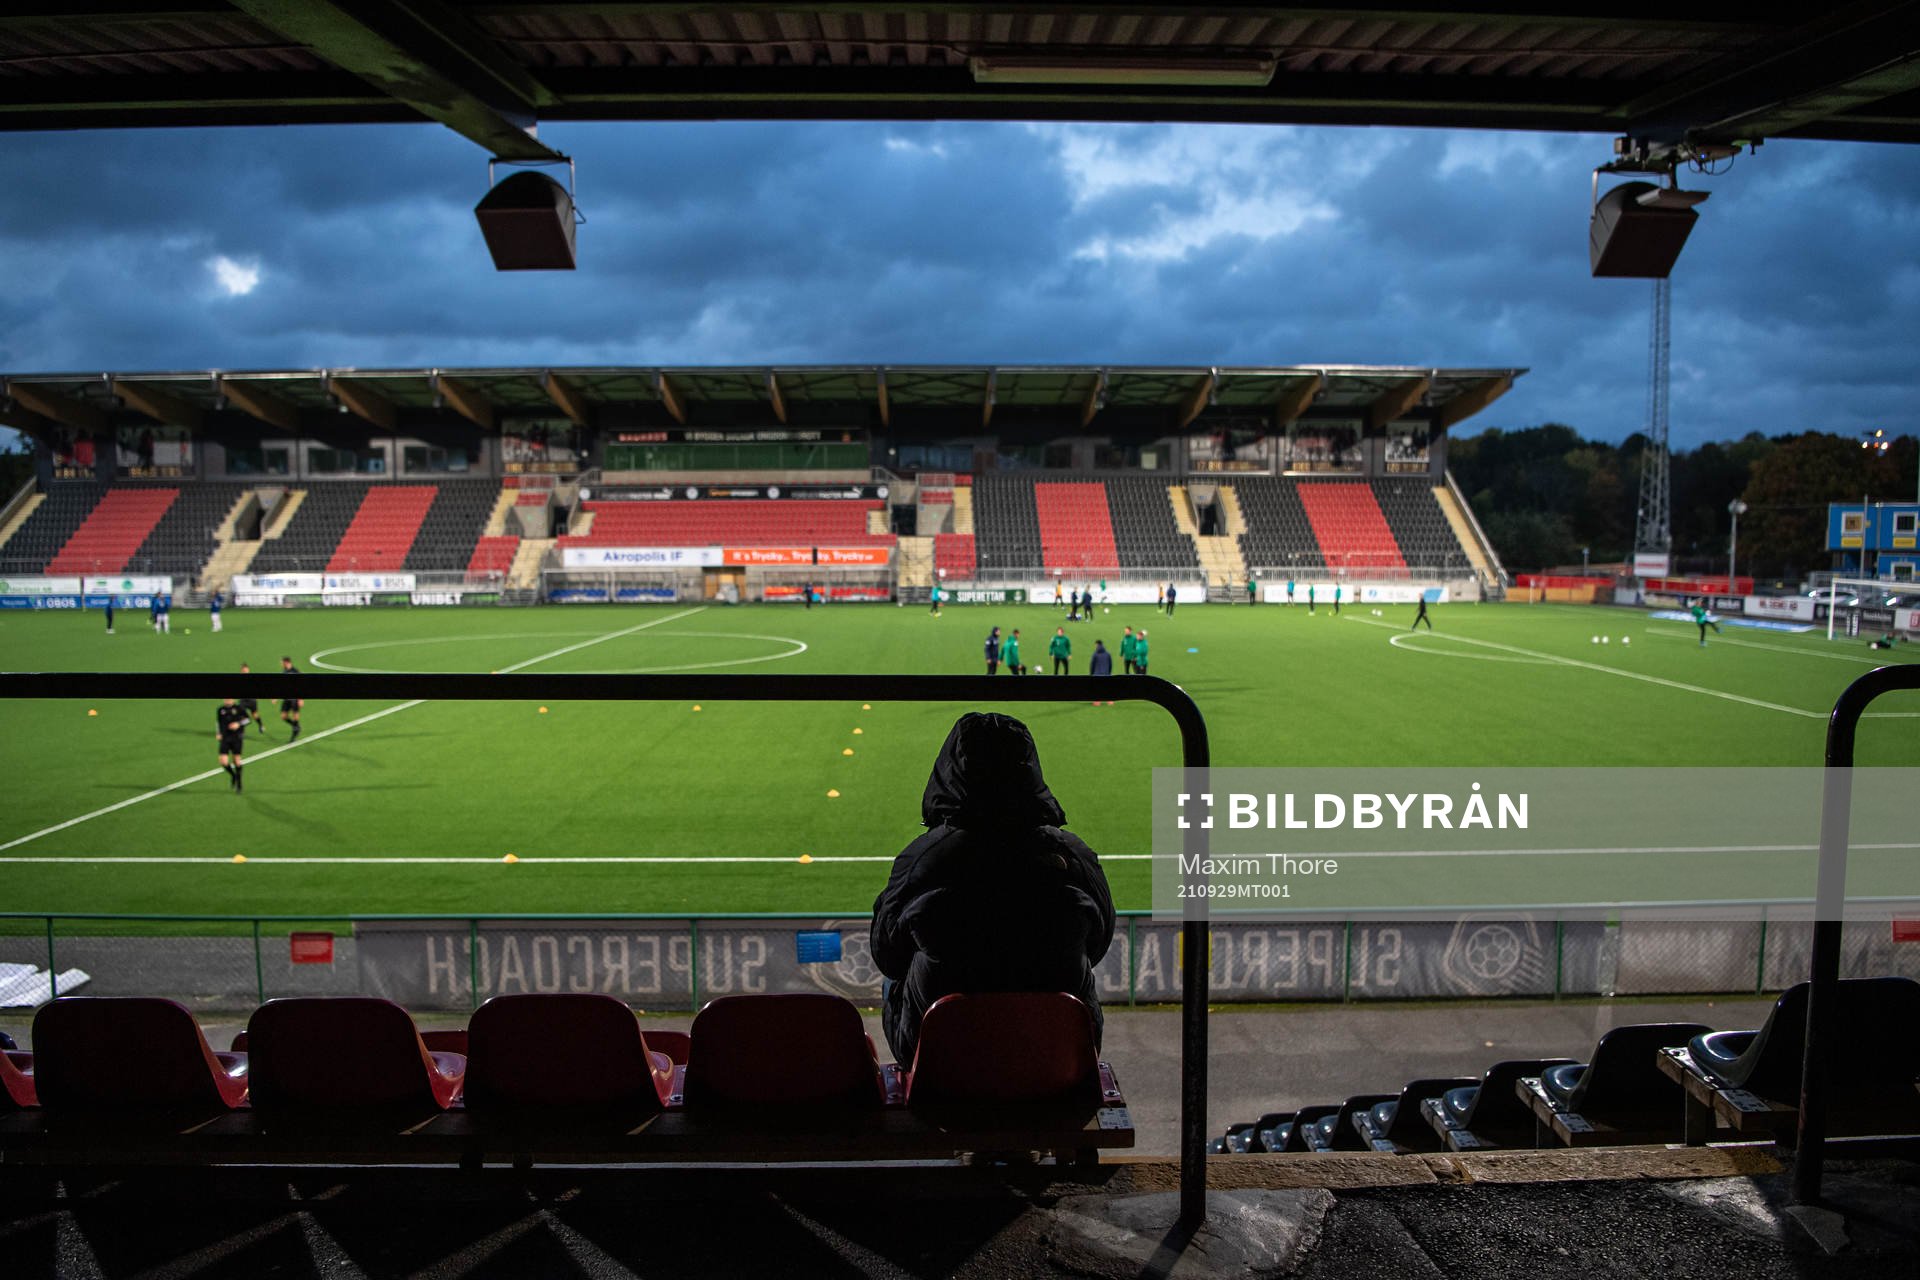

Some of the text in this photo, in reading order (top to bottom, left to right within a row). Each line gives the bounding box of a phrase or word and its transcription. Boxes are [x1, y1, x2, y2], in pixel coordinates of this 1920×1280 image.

[603, 552, 683, 562] Akropolis IF
[235, 594, 285, 606] UNIBET
[322, 593, 373, 606] UNIBET
[410, 592, 463, 605] UNIBET
